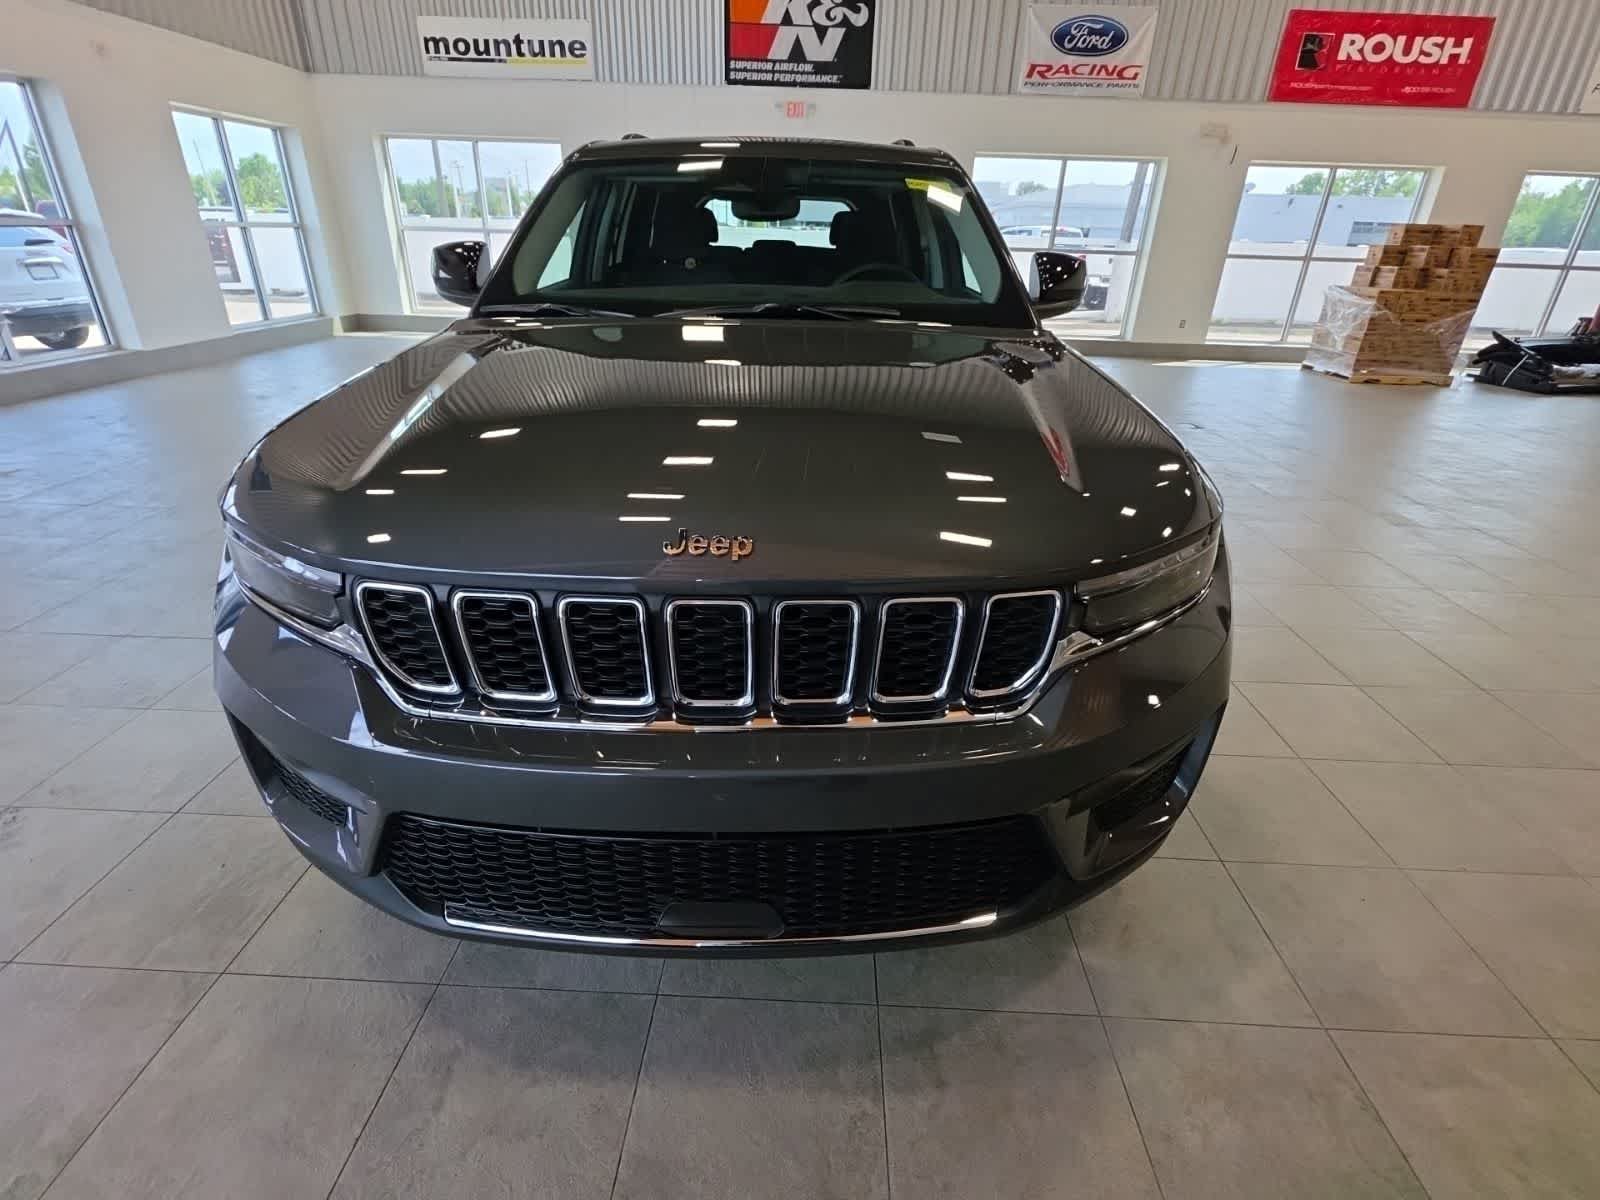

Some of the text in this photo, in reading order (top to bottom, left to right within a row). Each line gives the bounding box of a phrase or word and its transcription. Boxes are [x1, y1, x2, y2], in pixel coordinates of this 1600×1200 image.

[423, 33, 588, 58] mountune
[1064, 21, 1115, 49] Ford
[1337, 33, 1474, 65] ROUSH
[729, 60, 773, 71] SUPERIOR
[729, 71, 773, 81] SUPERIOR
[1026, 63, 1144, 81] RACING
[662, 527, 753, 561] Jeep
